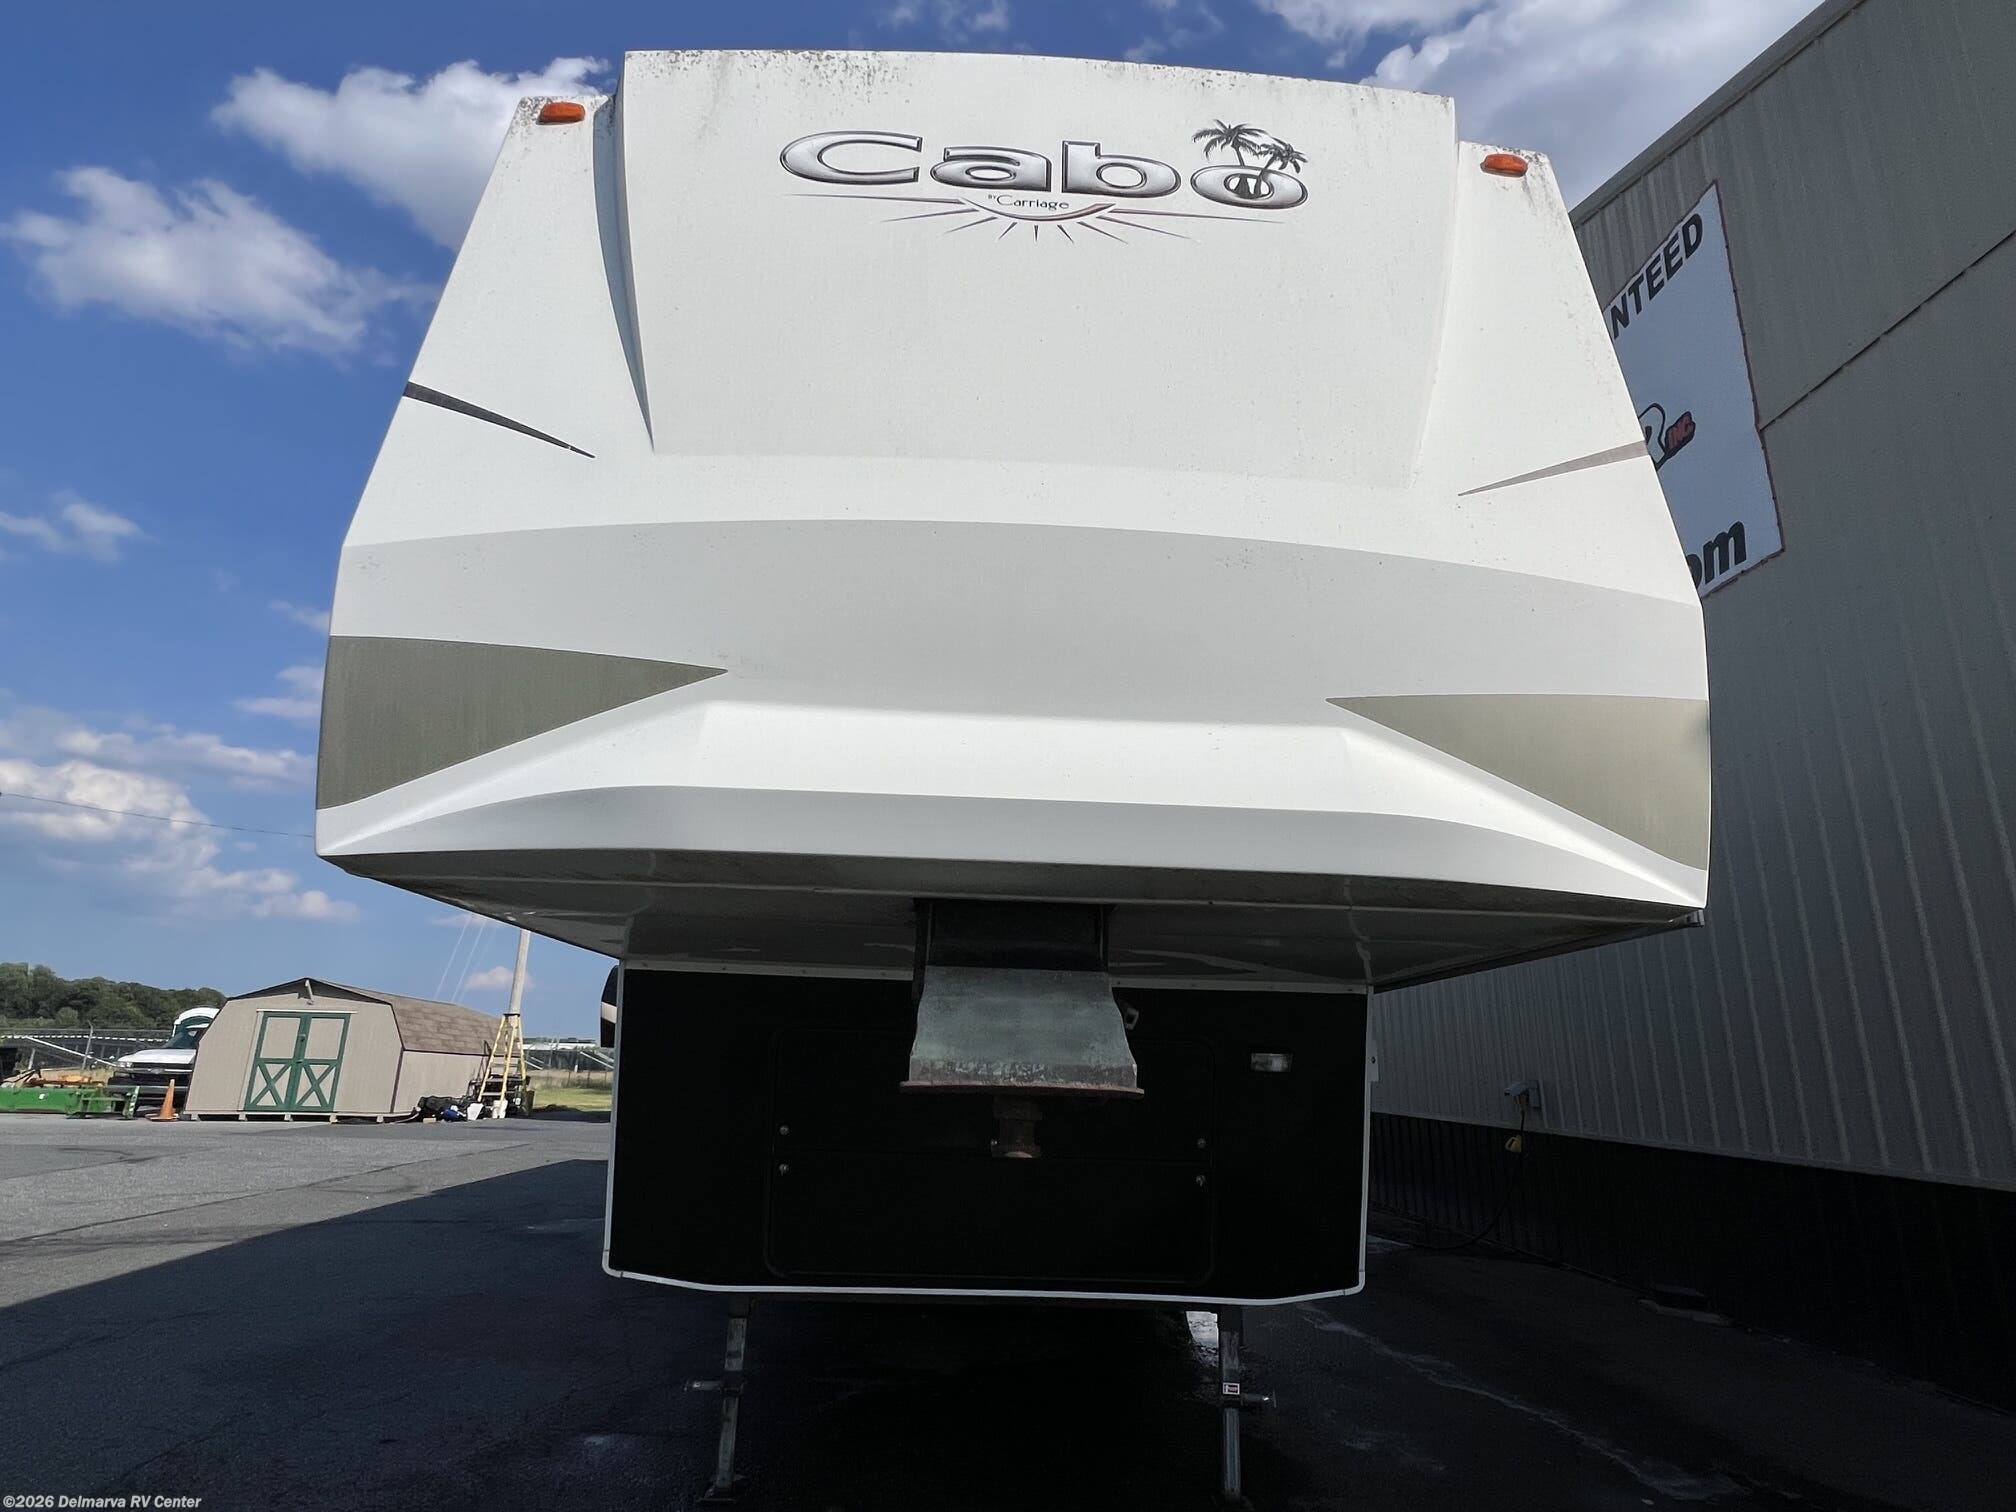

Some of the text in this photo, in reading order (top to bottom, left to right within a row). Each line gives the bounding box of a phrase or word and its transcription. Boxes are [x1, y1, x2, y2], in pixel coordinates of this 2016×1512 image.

[780, 131, 1308, 209] Cabo
[997, 195, 1069, 211] Carriage
[1610, 213, 1703, 340] NTEED
